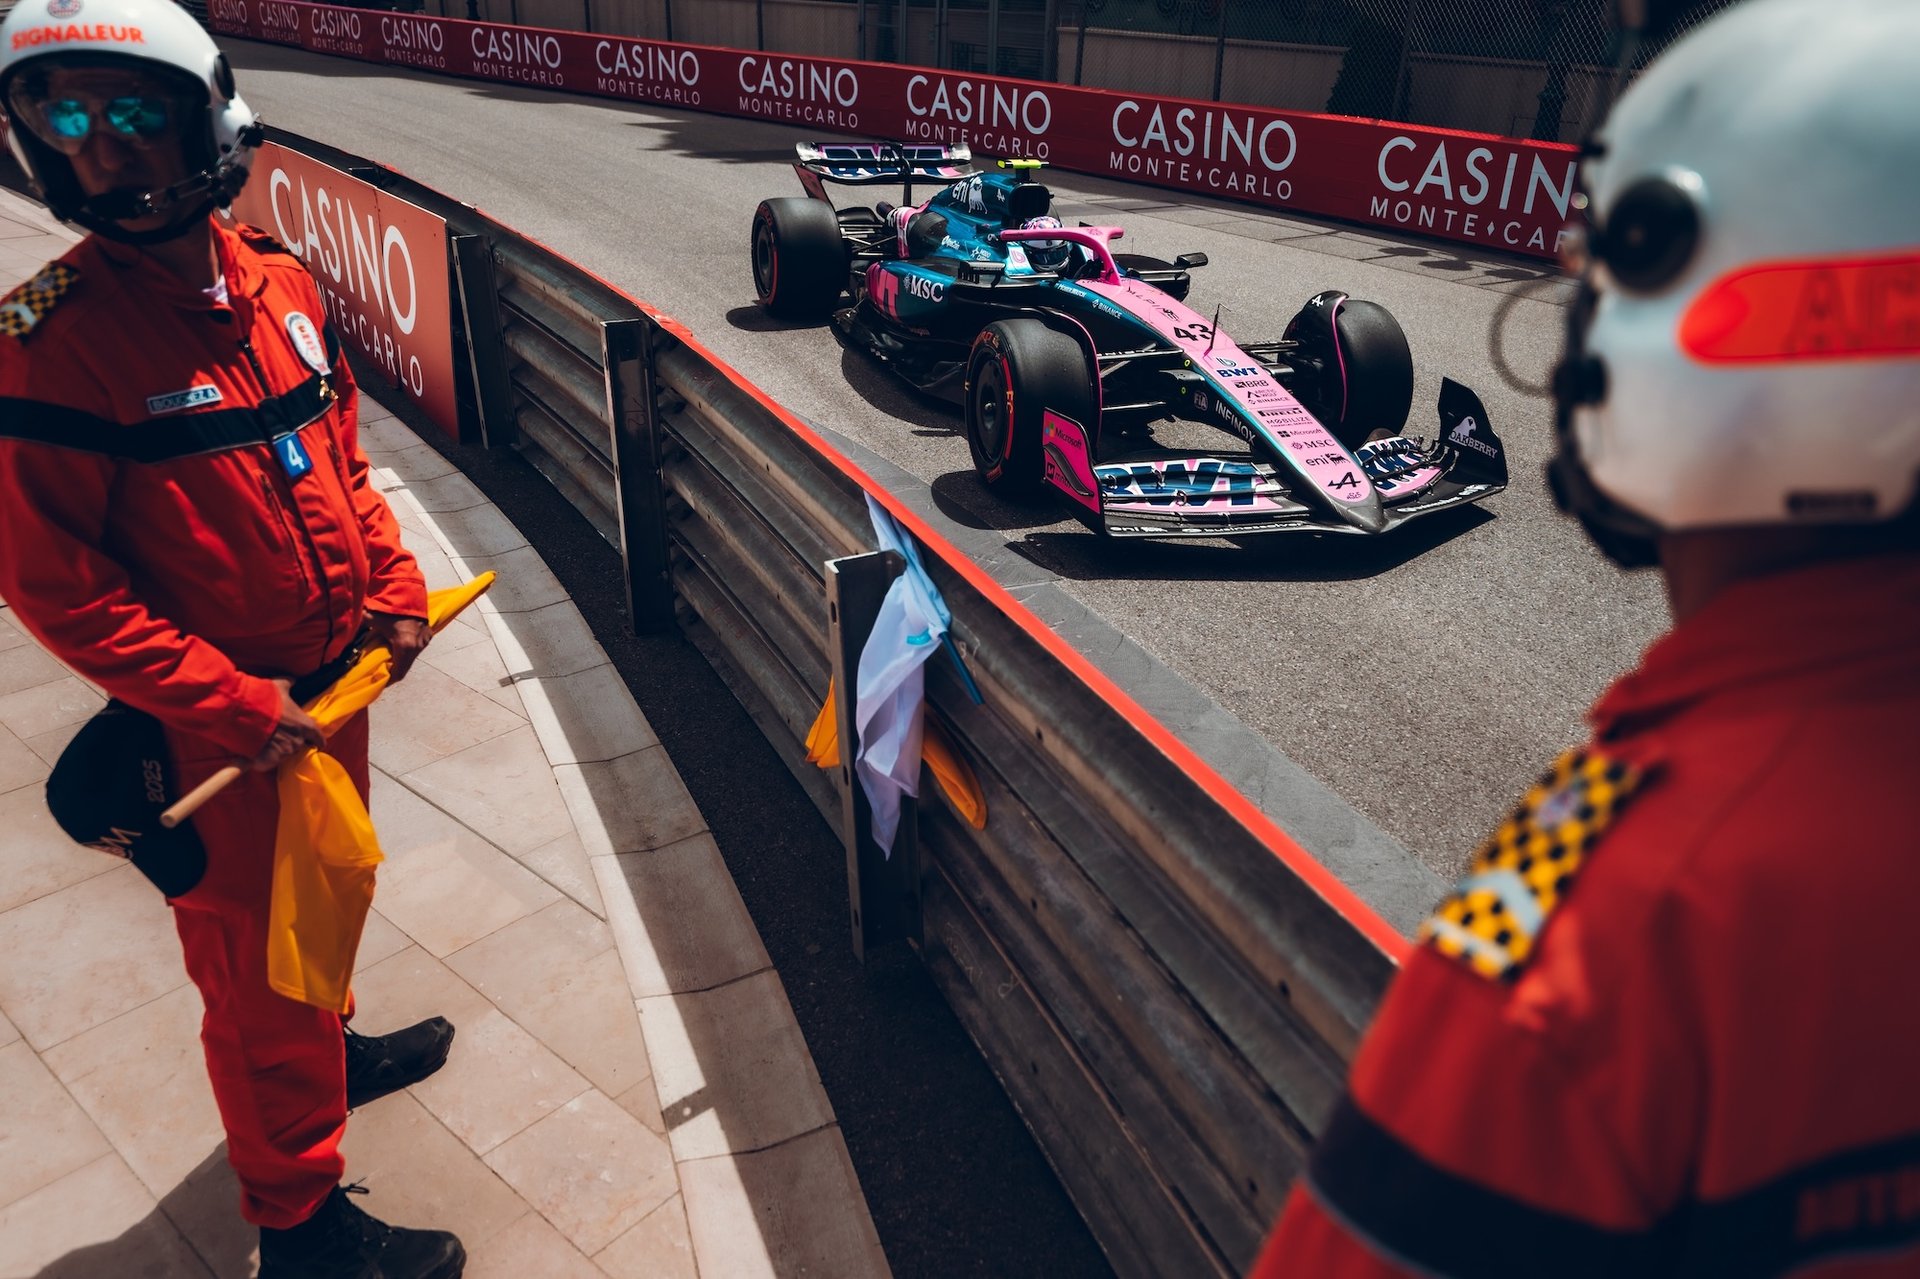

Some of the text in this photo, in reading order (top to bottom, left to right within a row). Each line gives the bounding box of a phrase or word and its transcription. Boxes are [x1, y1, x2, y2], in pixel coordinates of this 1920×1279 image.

[259, 2, 299, 30] CASINO
[311, 8, 361, 40] CASINO
[11, 24, 146, 51] SIGNALEUR
[381, 17, 443, 52] CASINO
[471, 27, 561, 69] CASINO
[384, 48, 446, 69] MONTE CARLO
[473, 61, 564, 86] MONTE CARLO
[596, 41, 700, 87] CASINO
[597, 77, 701, 106] MONTE CARLO
[739, 56, 859, 108] CASINO
[740, 96, 859, 129] MONTE CARLO
[906, 75, 1052, 135] CASINO
[906, 119, 1050, 159] MONTE CARLO
[1112, 100, 1297, 171] CASINO
[1110, 151, 1293, 200] MONTE CARLO
[1378, 136, 1577, 221] CASIN
[952, 180, 968, 203] eni
[1371, 196, 1570, 253] MONTE CAR
[270, 168, 416, 335] CASINO
[910, 274, 945, 303] MSC
[1097, 302, 1123, 320] BINANCE
[1173, 323, 1213, 341] 43
[359, 313, 424, 397] CARLO
[1216, 367, 1259, 378] BWT
[1246, 380, 1269, 388] BRB
[1215, 400, 1256, 445] INFINOX
[1258, 407, 1303, 417] PIRELLI
[1055, 427, 1083, 449] Microsoft
[1290, 428, 1324, 436] Microsoft
[1303, 439, 1335, 449] MSC
[1449, 430, 1498, 459] OAKBERRY
[286, 439, 305, 470] 4
[1305, 455, 1329, 467] eni
[142, 759, 166, 804] 2025
